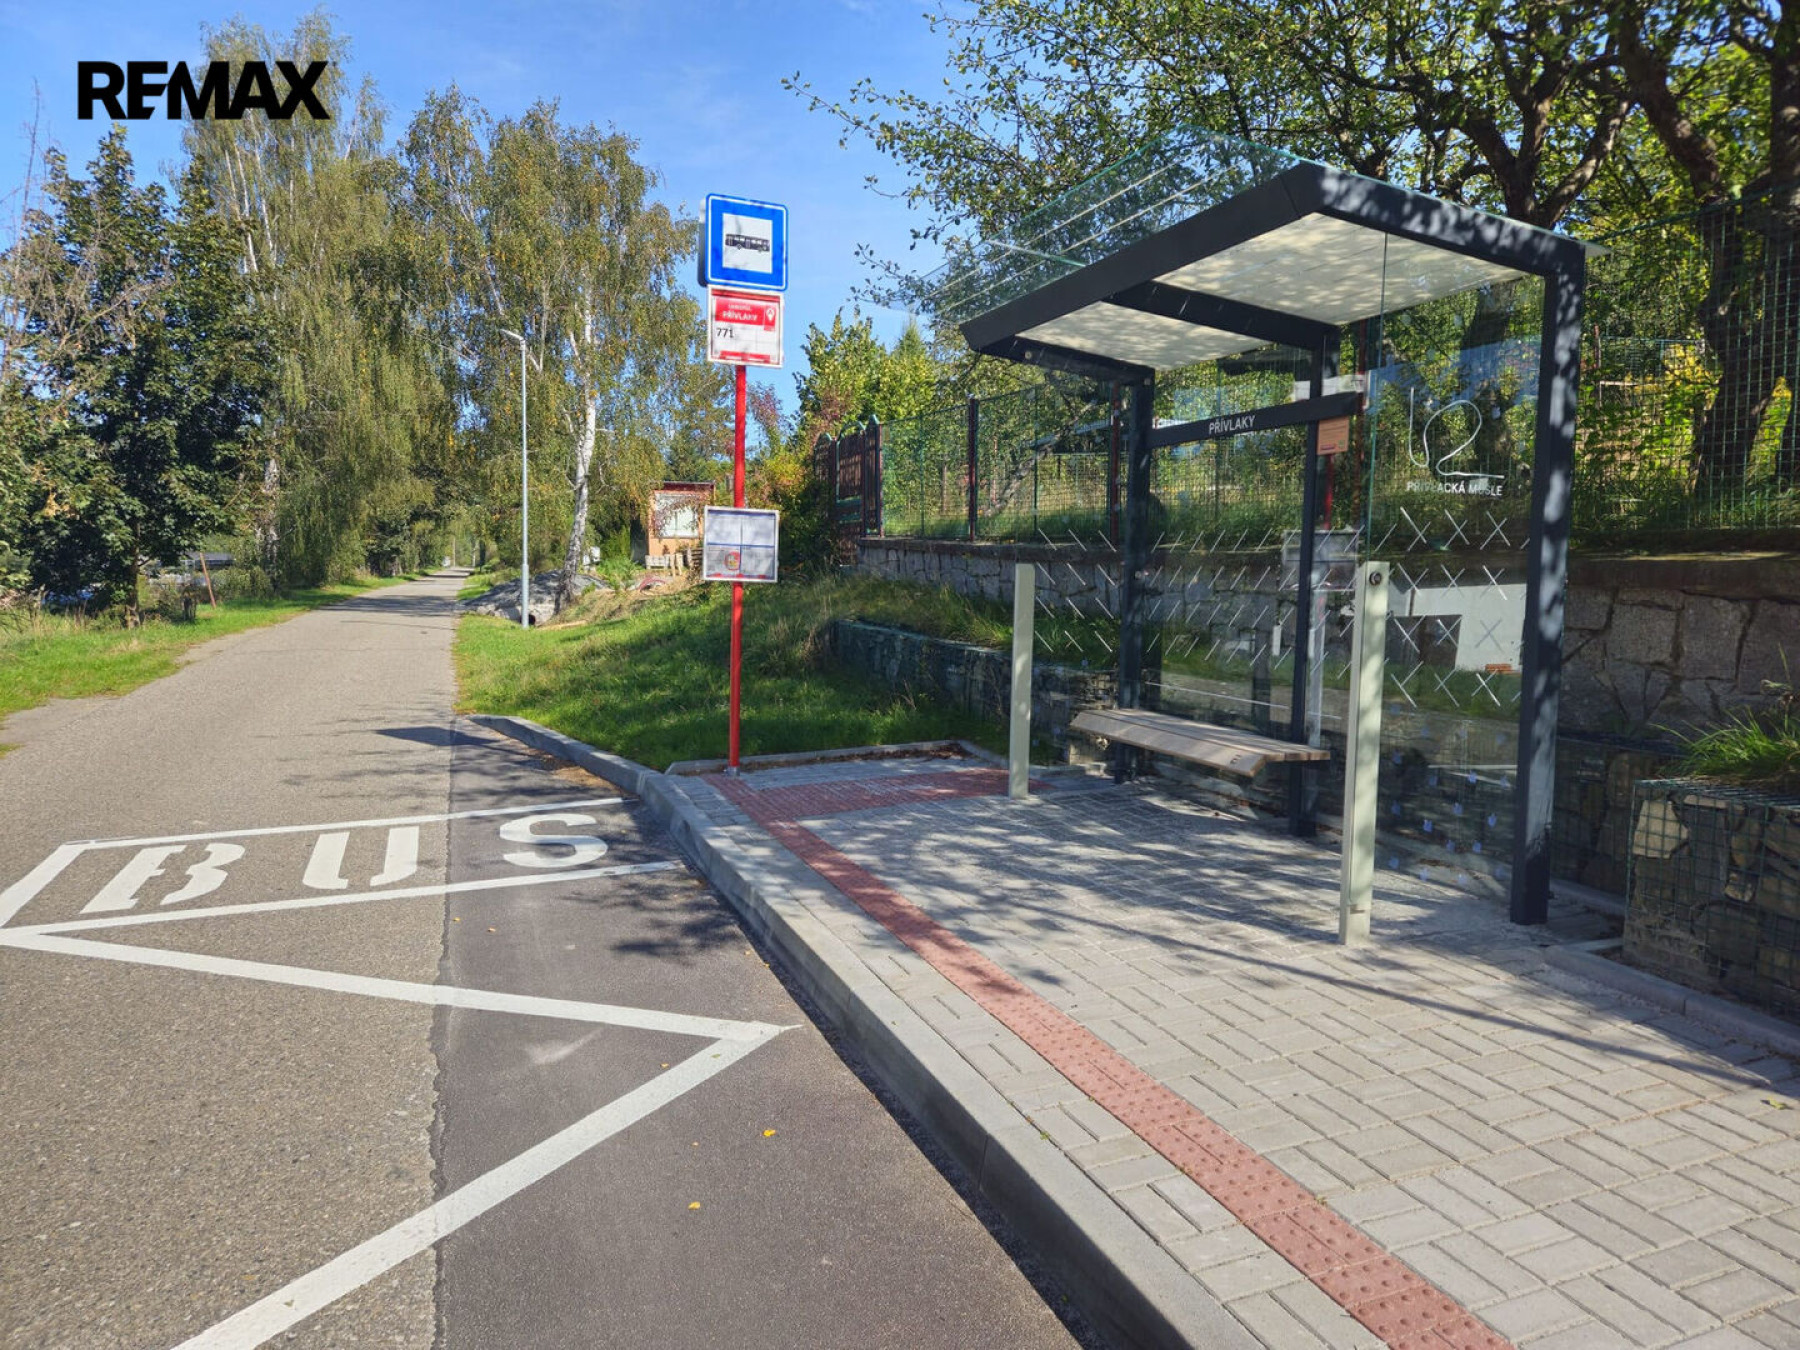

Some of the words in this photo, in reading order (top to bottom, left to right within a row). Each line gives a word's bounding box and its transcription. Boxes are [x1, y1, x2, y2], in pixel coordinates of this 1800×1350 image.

[716, 327, 734, 338] 771
[1208, 414, 1256, 436] PŘÍVLAKY
[79, 813, 608, 915] BUS
